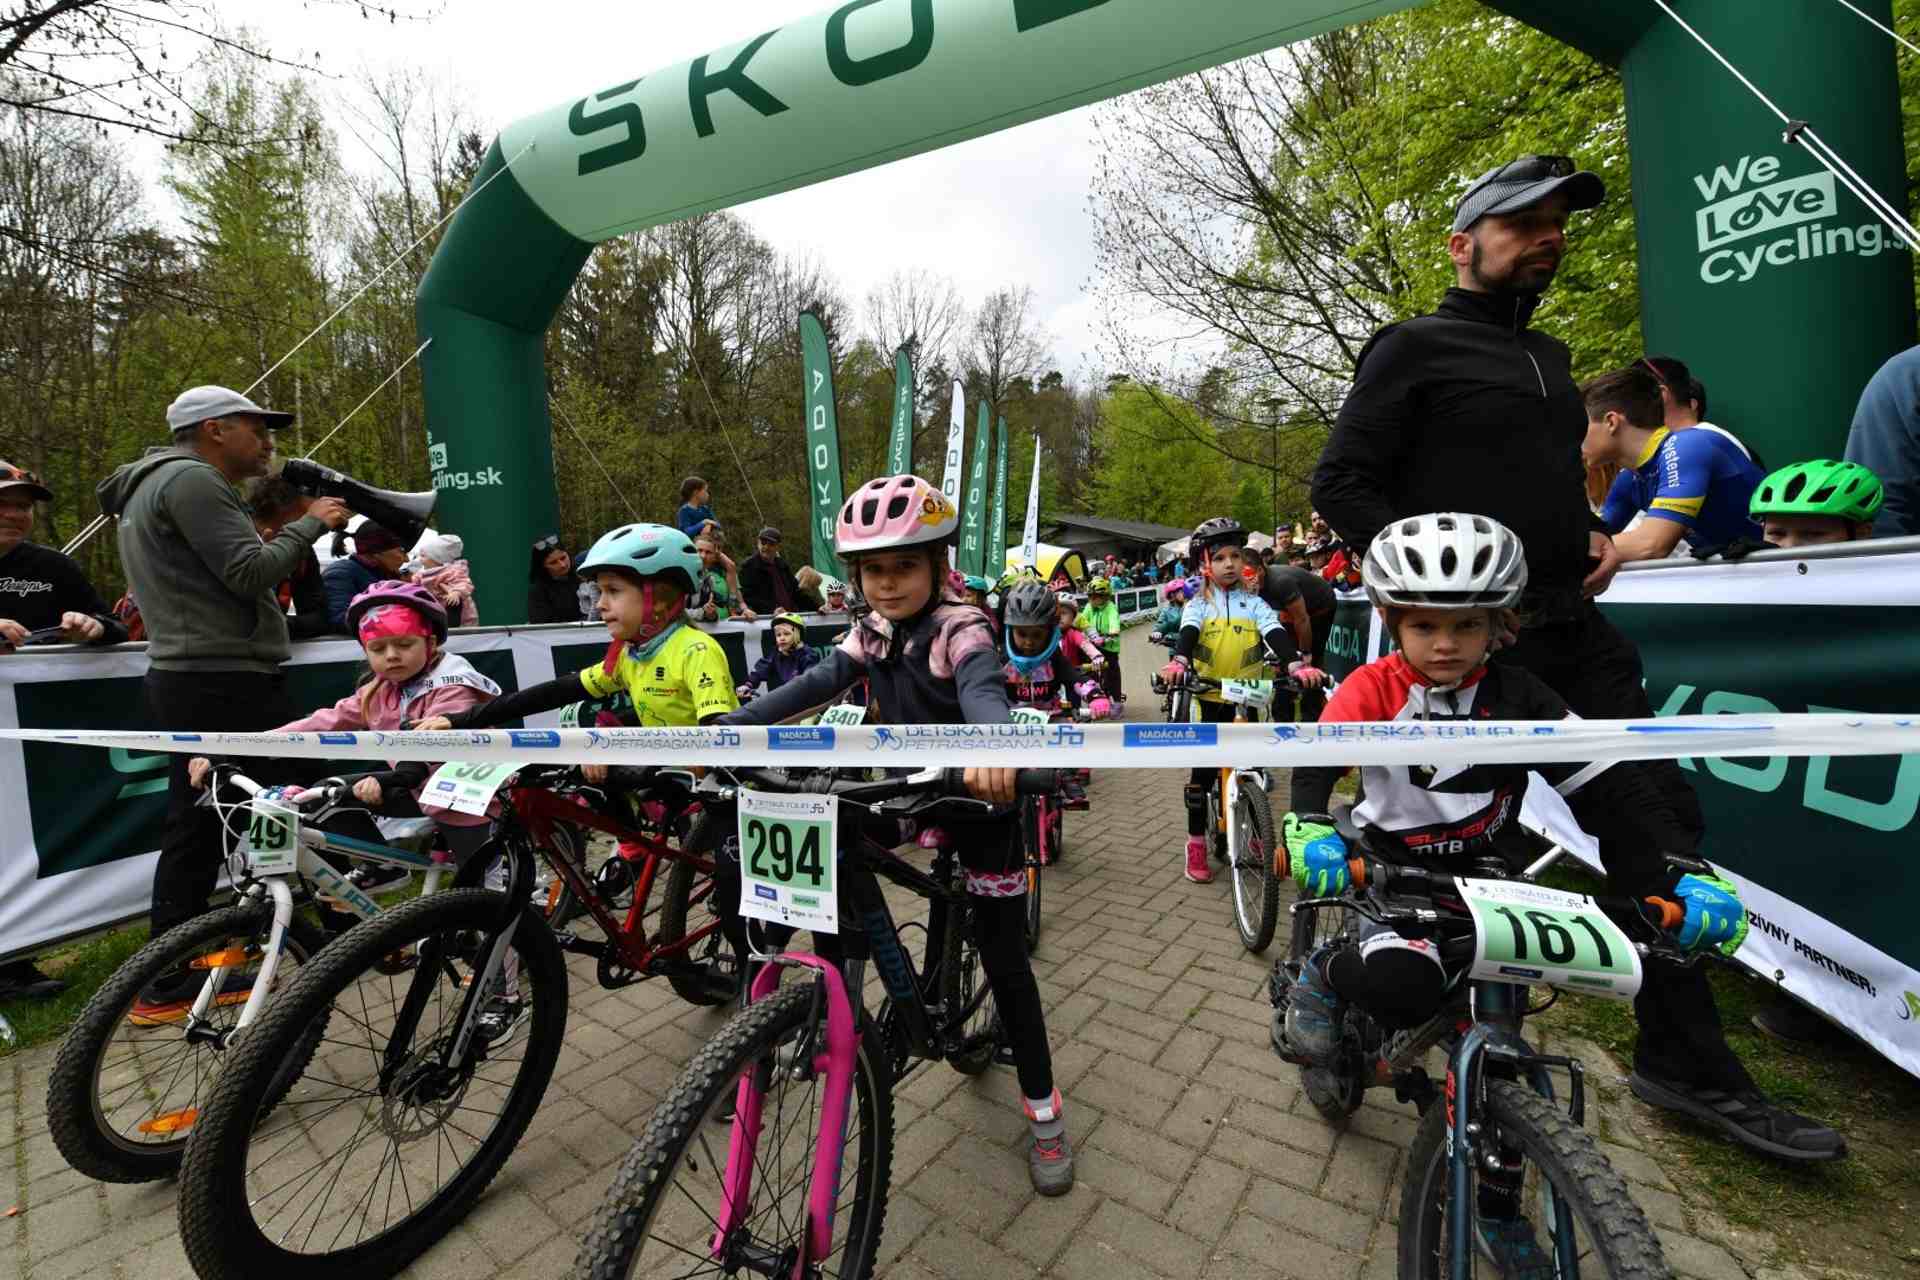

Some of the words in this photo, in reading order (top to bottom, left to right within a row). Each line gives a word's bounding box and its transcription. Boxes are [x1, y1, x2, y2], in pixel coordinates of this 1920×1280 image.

[1694, 155, 1780, 202] We
[748, 819, 824, 886] 294
[1494, 906, 1613, 968] 161
[1793, 937, 1877, 998] PARTNER:
